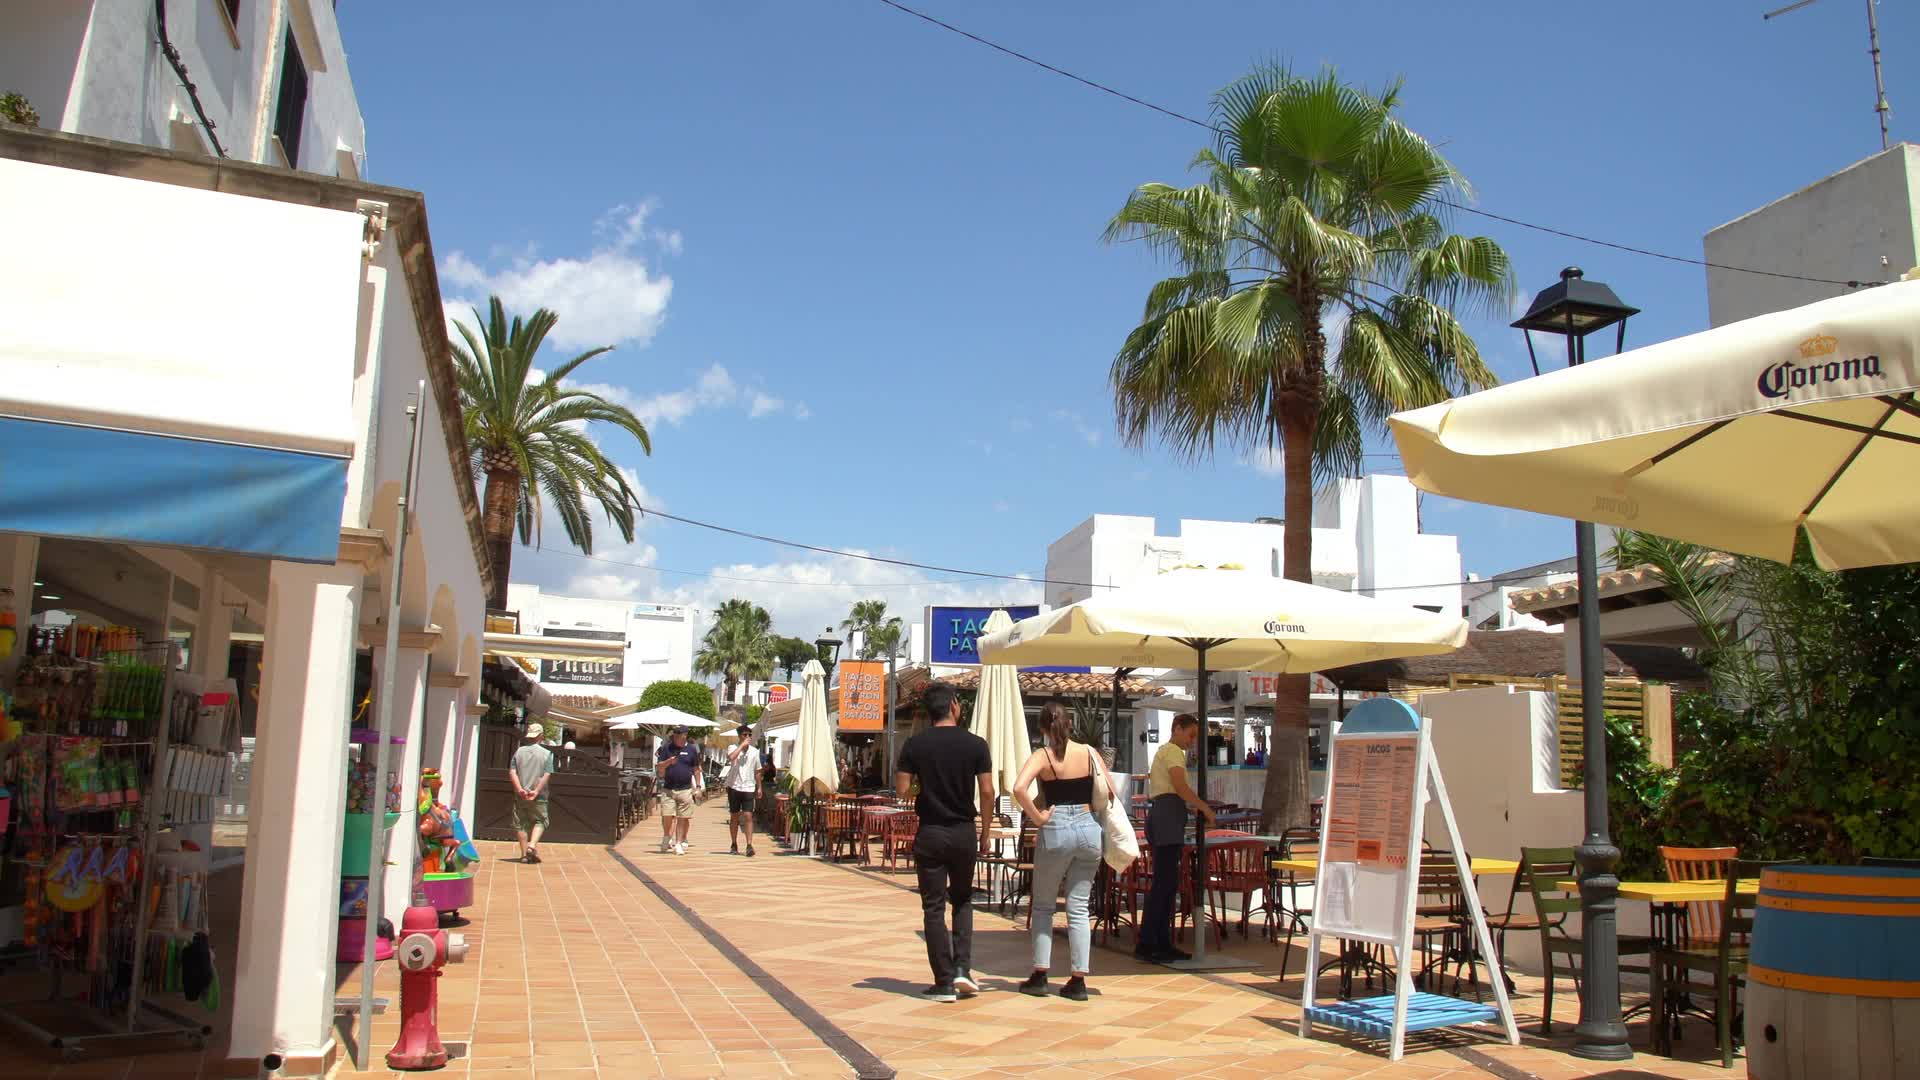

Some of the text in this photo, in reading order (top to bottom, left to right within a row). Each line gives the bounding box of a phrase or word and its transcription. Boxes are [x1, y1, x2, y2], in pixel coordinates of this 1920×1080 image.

[1757, 355, 1881, 399] Corona
[1264, 621, 1305, 635] Corona
[571, 673, 593, 682] terrace
[844, 672, 880, 682] TACOS
[844, 682, 880, 691] TACOS
[844, 701, 880, 711] TACOS
